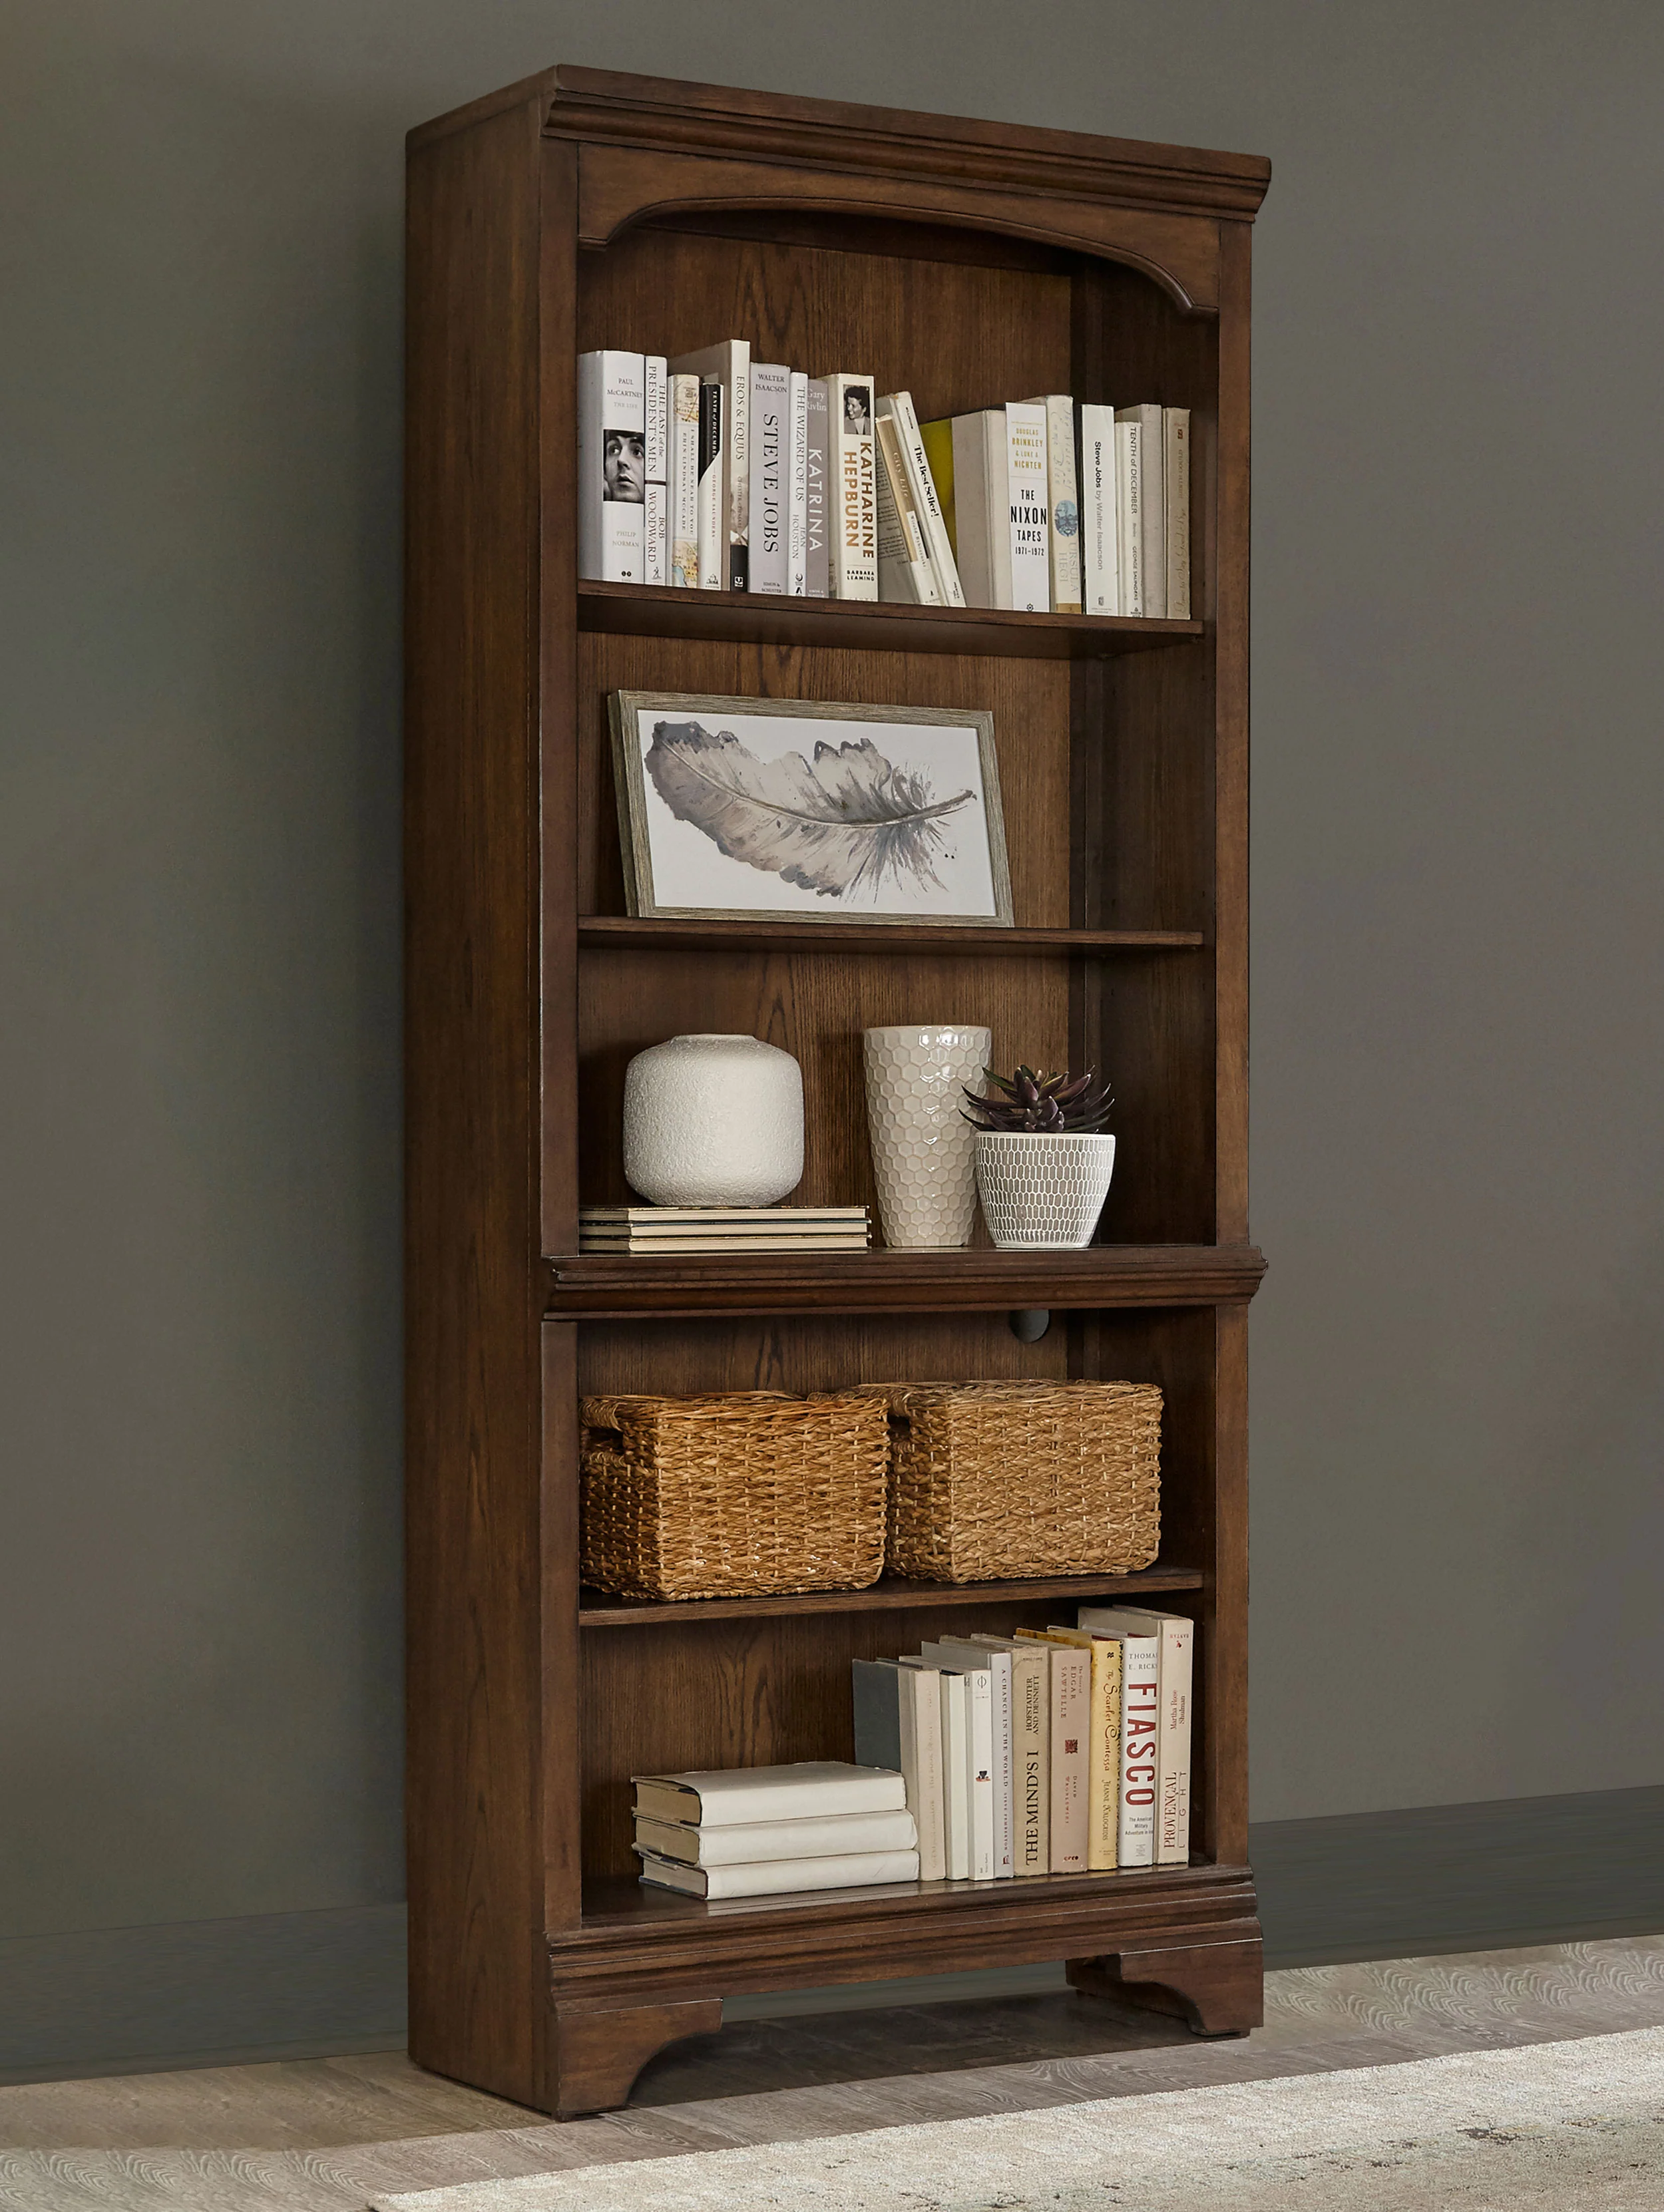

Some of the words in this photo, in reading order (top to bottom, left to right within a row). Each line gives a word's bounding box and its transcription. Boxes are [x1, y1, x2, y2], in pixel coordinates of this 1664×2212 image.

[736, 376, 745, 405] EROS
[755, 384, 787, 393] ISAACSON
[758, 373, 784, 383] WALTER
[797, 387, 805, 411] THE
[807, 389, 825, 402] Gary
[736, 409, 745, 417] &
[734, 422, 745, 460] EQUUS
[763, 414, 779, 489] STEVE
[1012, 437, 1043, 447] BRINKLEY
[795, 467, 804, 484] OF
[1014, 461, 1042, 470] NICHTER
[1131, 459, 1137, 468] of
[795, 487, 804, 501] US
[899, 478, 909, 498] Life
[914, 445, 923, 464] The
[919, 465, 930, 485] Best
[925, 486, 940, 518] Seller!
[808, 449, 823, 551] KATRINA
[844, 452, 859, 547] HEPBURN
[861, 443, 874, 558] KATHARINE
[1021, 490, 1034, 500] THE
[1095, 490, 1102, 500] by
[648, 491, 657, 562] WOODWARD
[763, 498, 778, 552] JOBS
[1010, 506, 1046, 525] NIXON
[1017, 530, 1041, 542] TAPES
[1059, 552, 1068, 582] HEGI
[1068, 542, 1079, 592] URSULA
[1103, 1683, 1118, 1722] Scarlet
[1002, 1719, 1008, 1729] IN
[1103, 1725, 1118, 1771] Contessa
[1126, 1683, 1157, 1806] FIASCO
[1026, 1762, 1038, 1825] MIND'S
[1102, 1779, 1111, 1801] JEANNE
[1164, 1771, 1179, 1849] PROVENÇAL
[1026, 1829, 1038, 1866] THE
